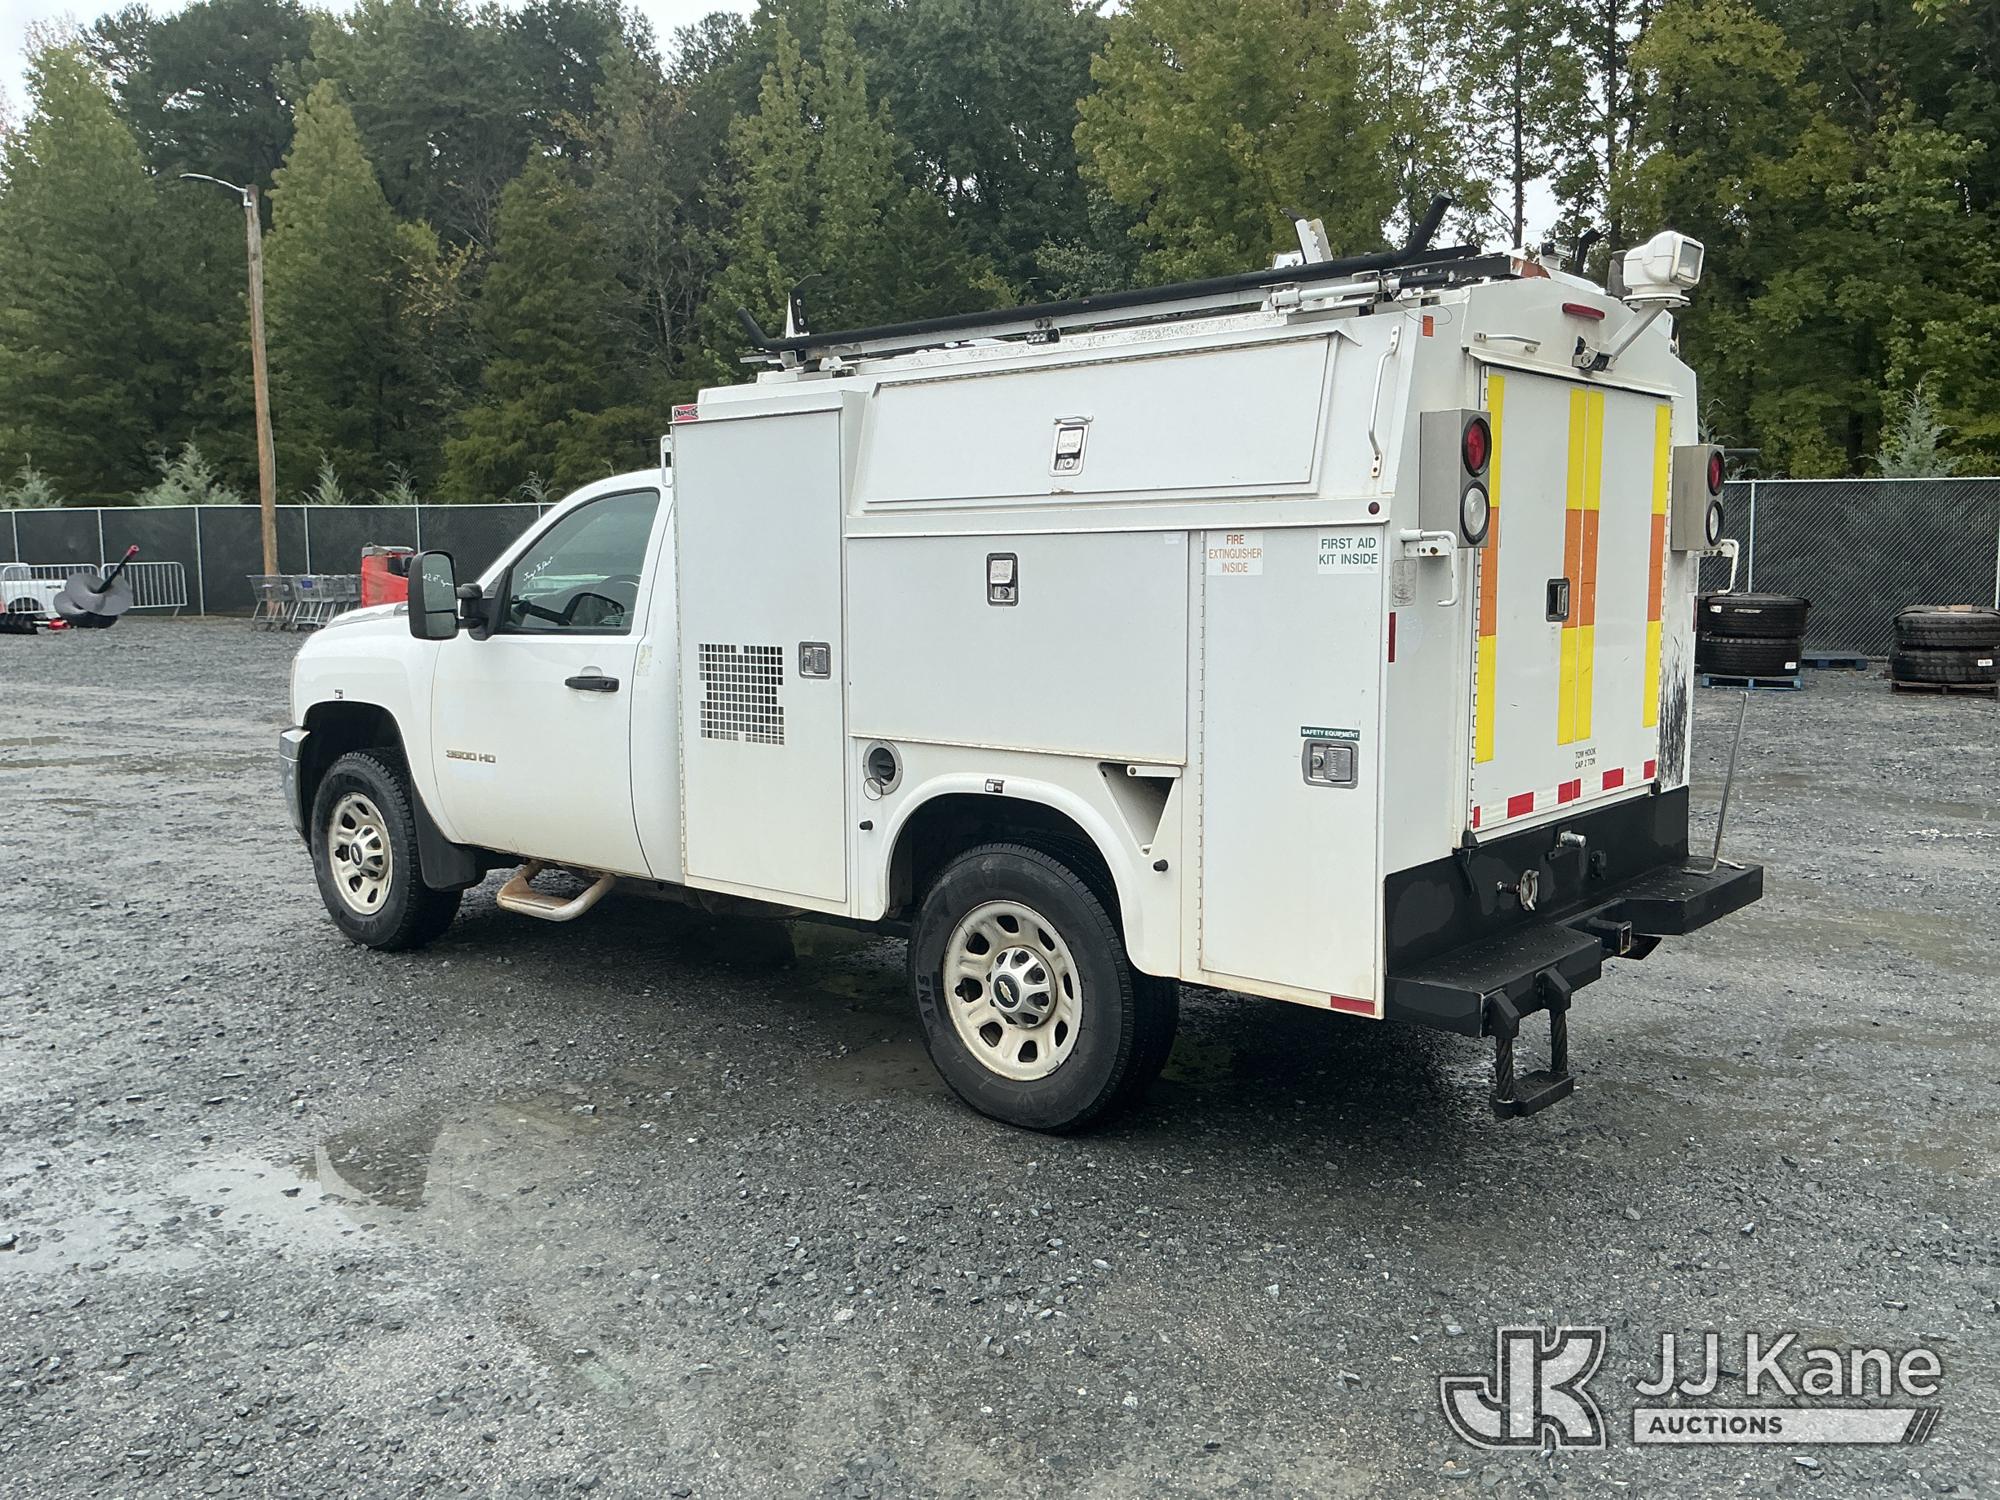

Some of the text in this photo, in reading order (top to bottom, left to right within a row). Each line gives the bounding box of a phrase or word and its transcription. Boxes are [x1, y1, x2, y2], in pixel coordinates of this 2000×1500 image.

[1226, 534, 1244, 545] FIRE
[1321, 537, 1376, 550] FIRST AID
[1208, 548, 1262, 560] EXTINGUISHER
[1318, 553, 1378, 565] KIT INSIDE
[1221, 562, 1248, 573] INSIDE
[1302, 728, 1358, 738] SAFETY EQUIPMENT
[479, 753, 496, 763] HD
[1575, 748, 1596, 759] TOW HOOK
[1575, 760, 1583, 769] CAP
[1587, 758, 1595, 766] TON
